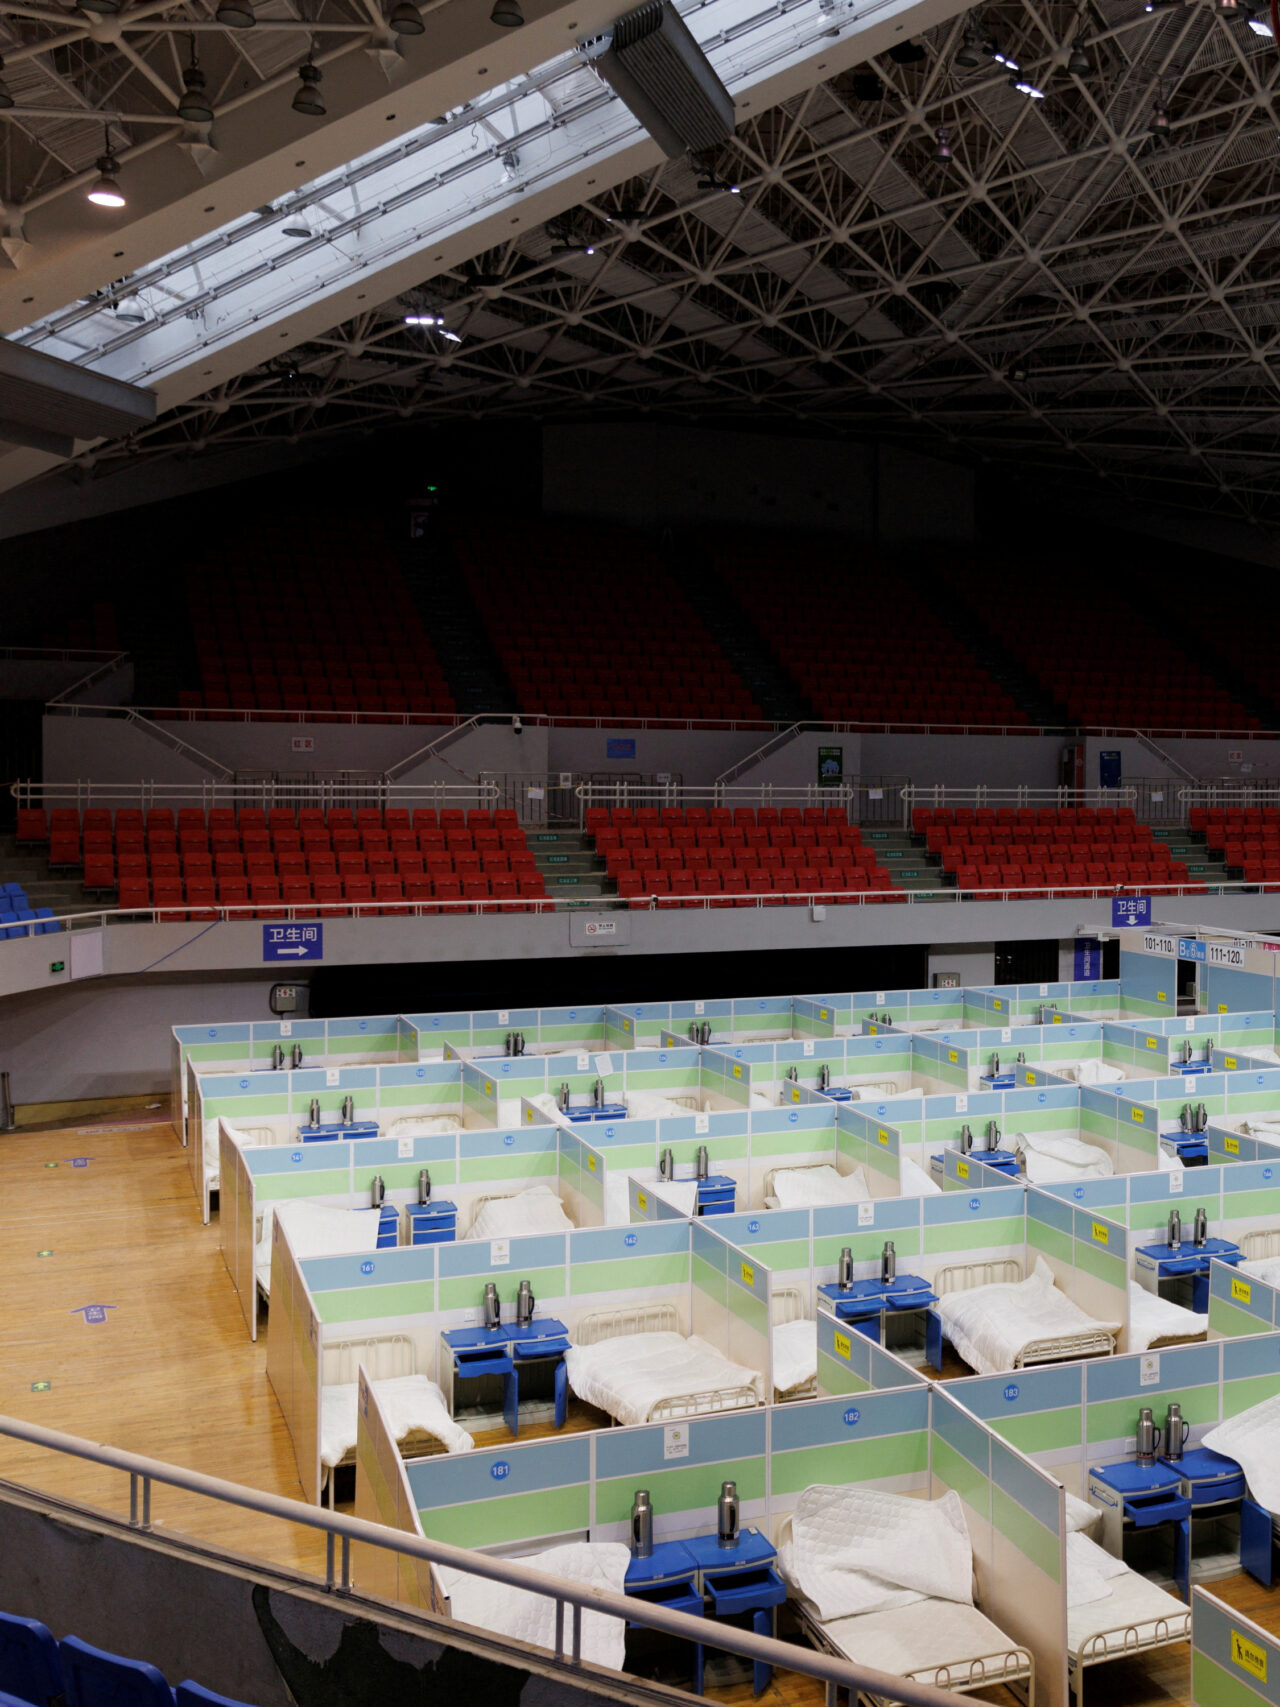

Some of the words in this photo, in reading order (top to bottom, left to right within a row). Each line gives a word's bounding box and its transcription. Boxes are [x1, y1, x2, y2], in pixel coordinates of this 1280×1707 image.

[1117, 900, 1147, 914] 卫生间
[269, 927, 318, 942] 卫生间
[625, 1236, 637, 1244] 162
[361, 1264, 374, 1272] 161
[1004, 1387, 1018, 1398] 183
[844, 1411, 859, 1422] 182
[493, 1465, 509, 1476] 181
